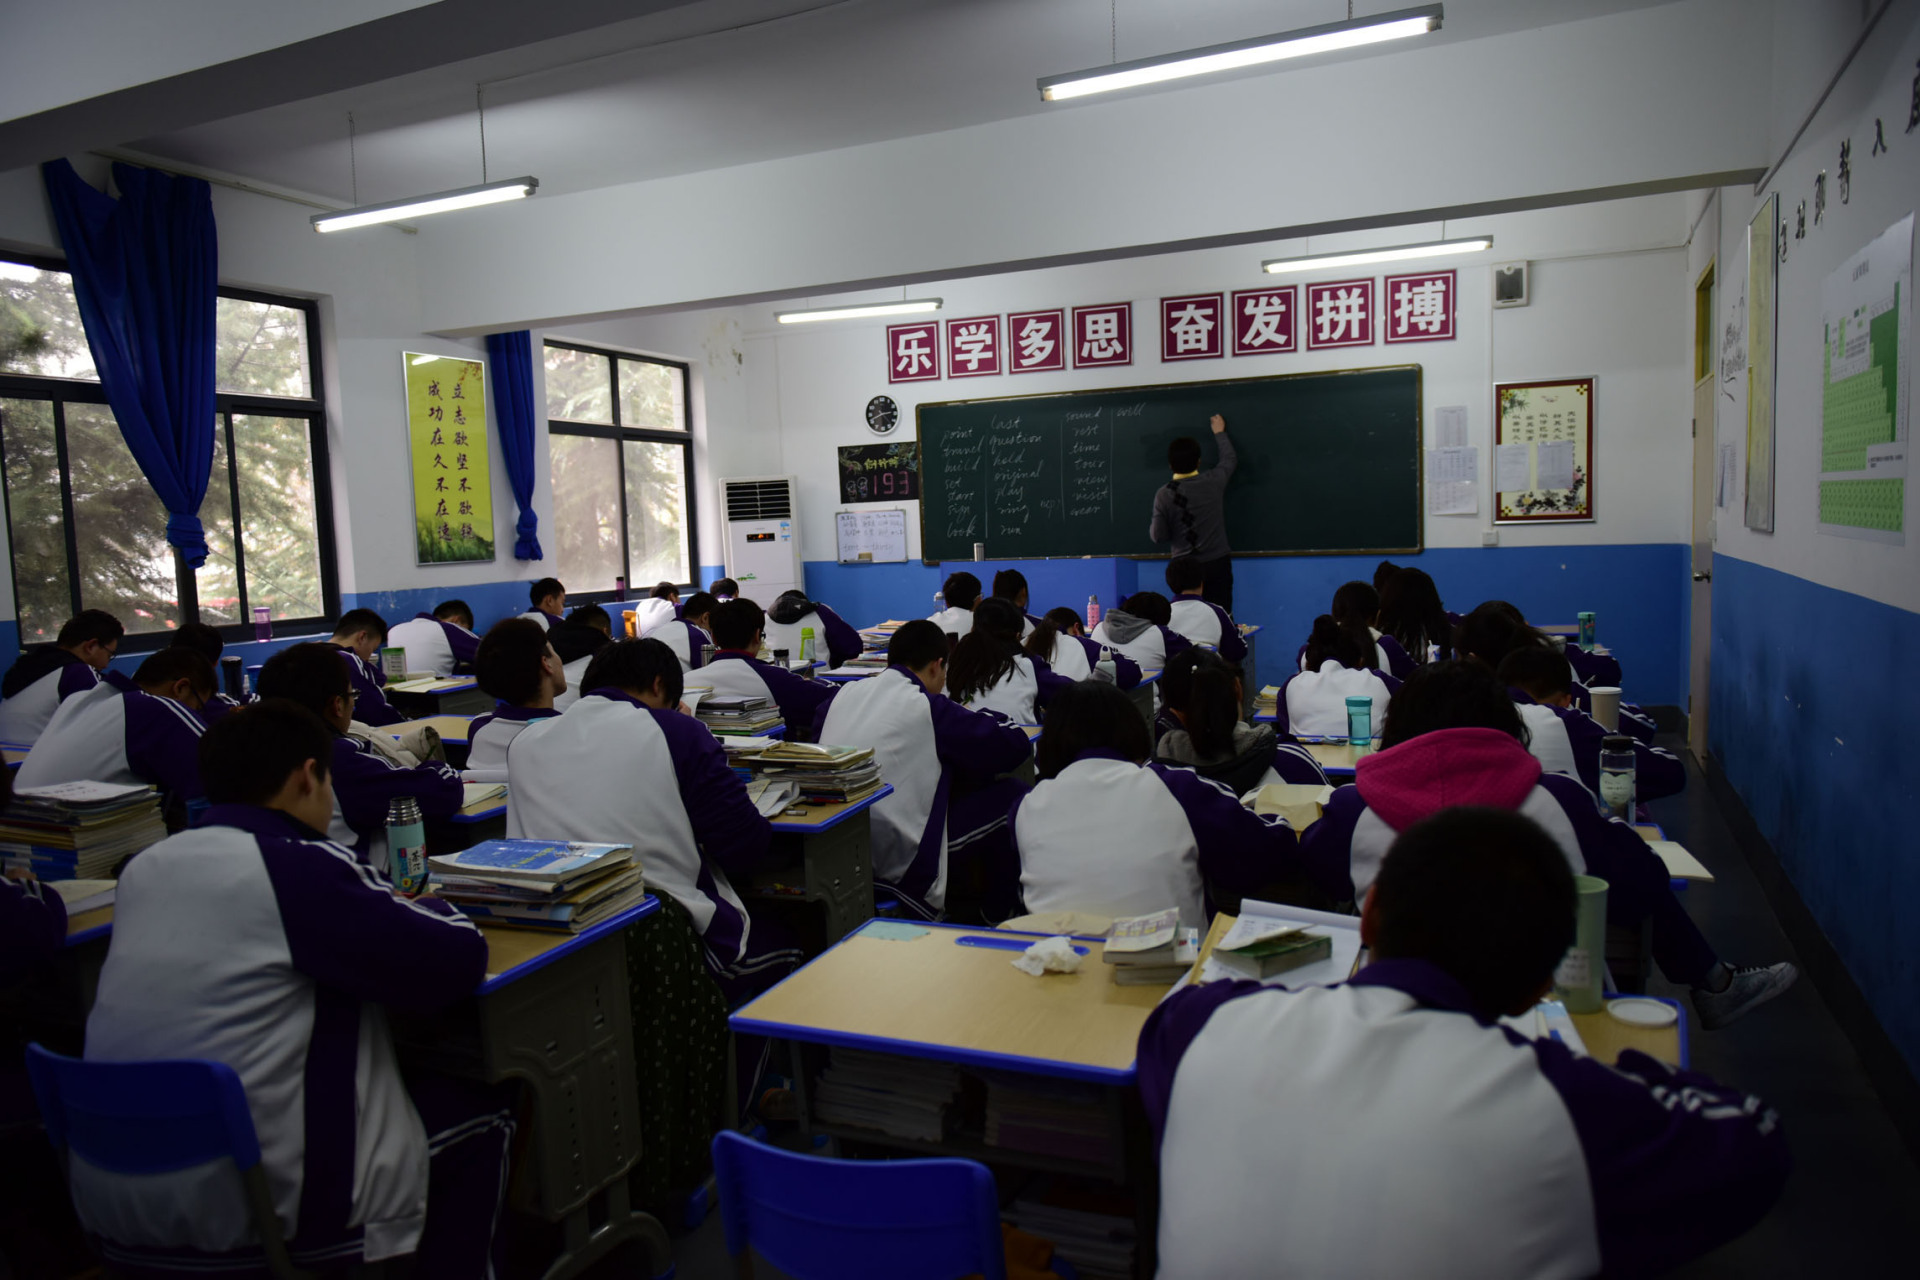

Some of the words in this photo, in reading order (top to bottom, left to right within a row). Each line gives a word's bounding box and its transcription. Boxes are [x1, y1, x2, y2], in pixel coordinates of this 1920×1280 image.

[895, 312, 1124, 376] 乐学多思
[1168, 279, 1447, 354] 奋发拼搏
[1065, 406, 1103, 422] sound
[1116, 402, 1145, 417] will
[990, 413, 1022, 430] last
[940, 426, 974, 448] point
[1072, 424, 1099, 437] rest
[943, 435, 985, 457] travel
[989, 431, 1042, 455] question
[1068, 441, 1101, 455] time
[428, 380, 452, 542] 成功在久不在速
[451, 383, 474, 541] 立志欲坚不欲锐
[863, 456, 900, 471] 倒计时
[944, 455, 981, 473] build
[1074, 458, 1105, 470] tour
[993, 460, 1042, 487] original
[1072, 472, 1108, 485] view
[873, 470, 910, 495] 193
[944, 477, 962, 490] set
[947, 489, 975, 503] start
[993, 482, 1024, 505] play
[1071, 486, 1108, 501] visit
[946, 514, 978, 538] look
[1000, 524, 1022, 536] run
